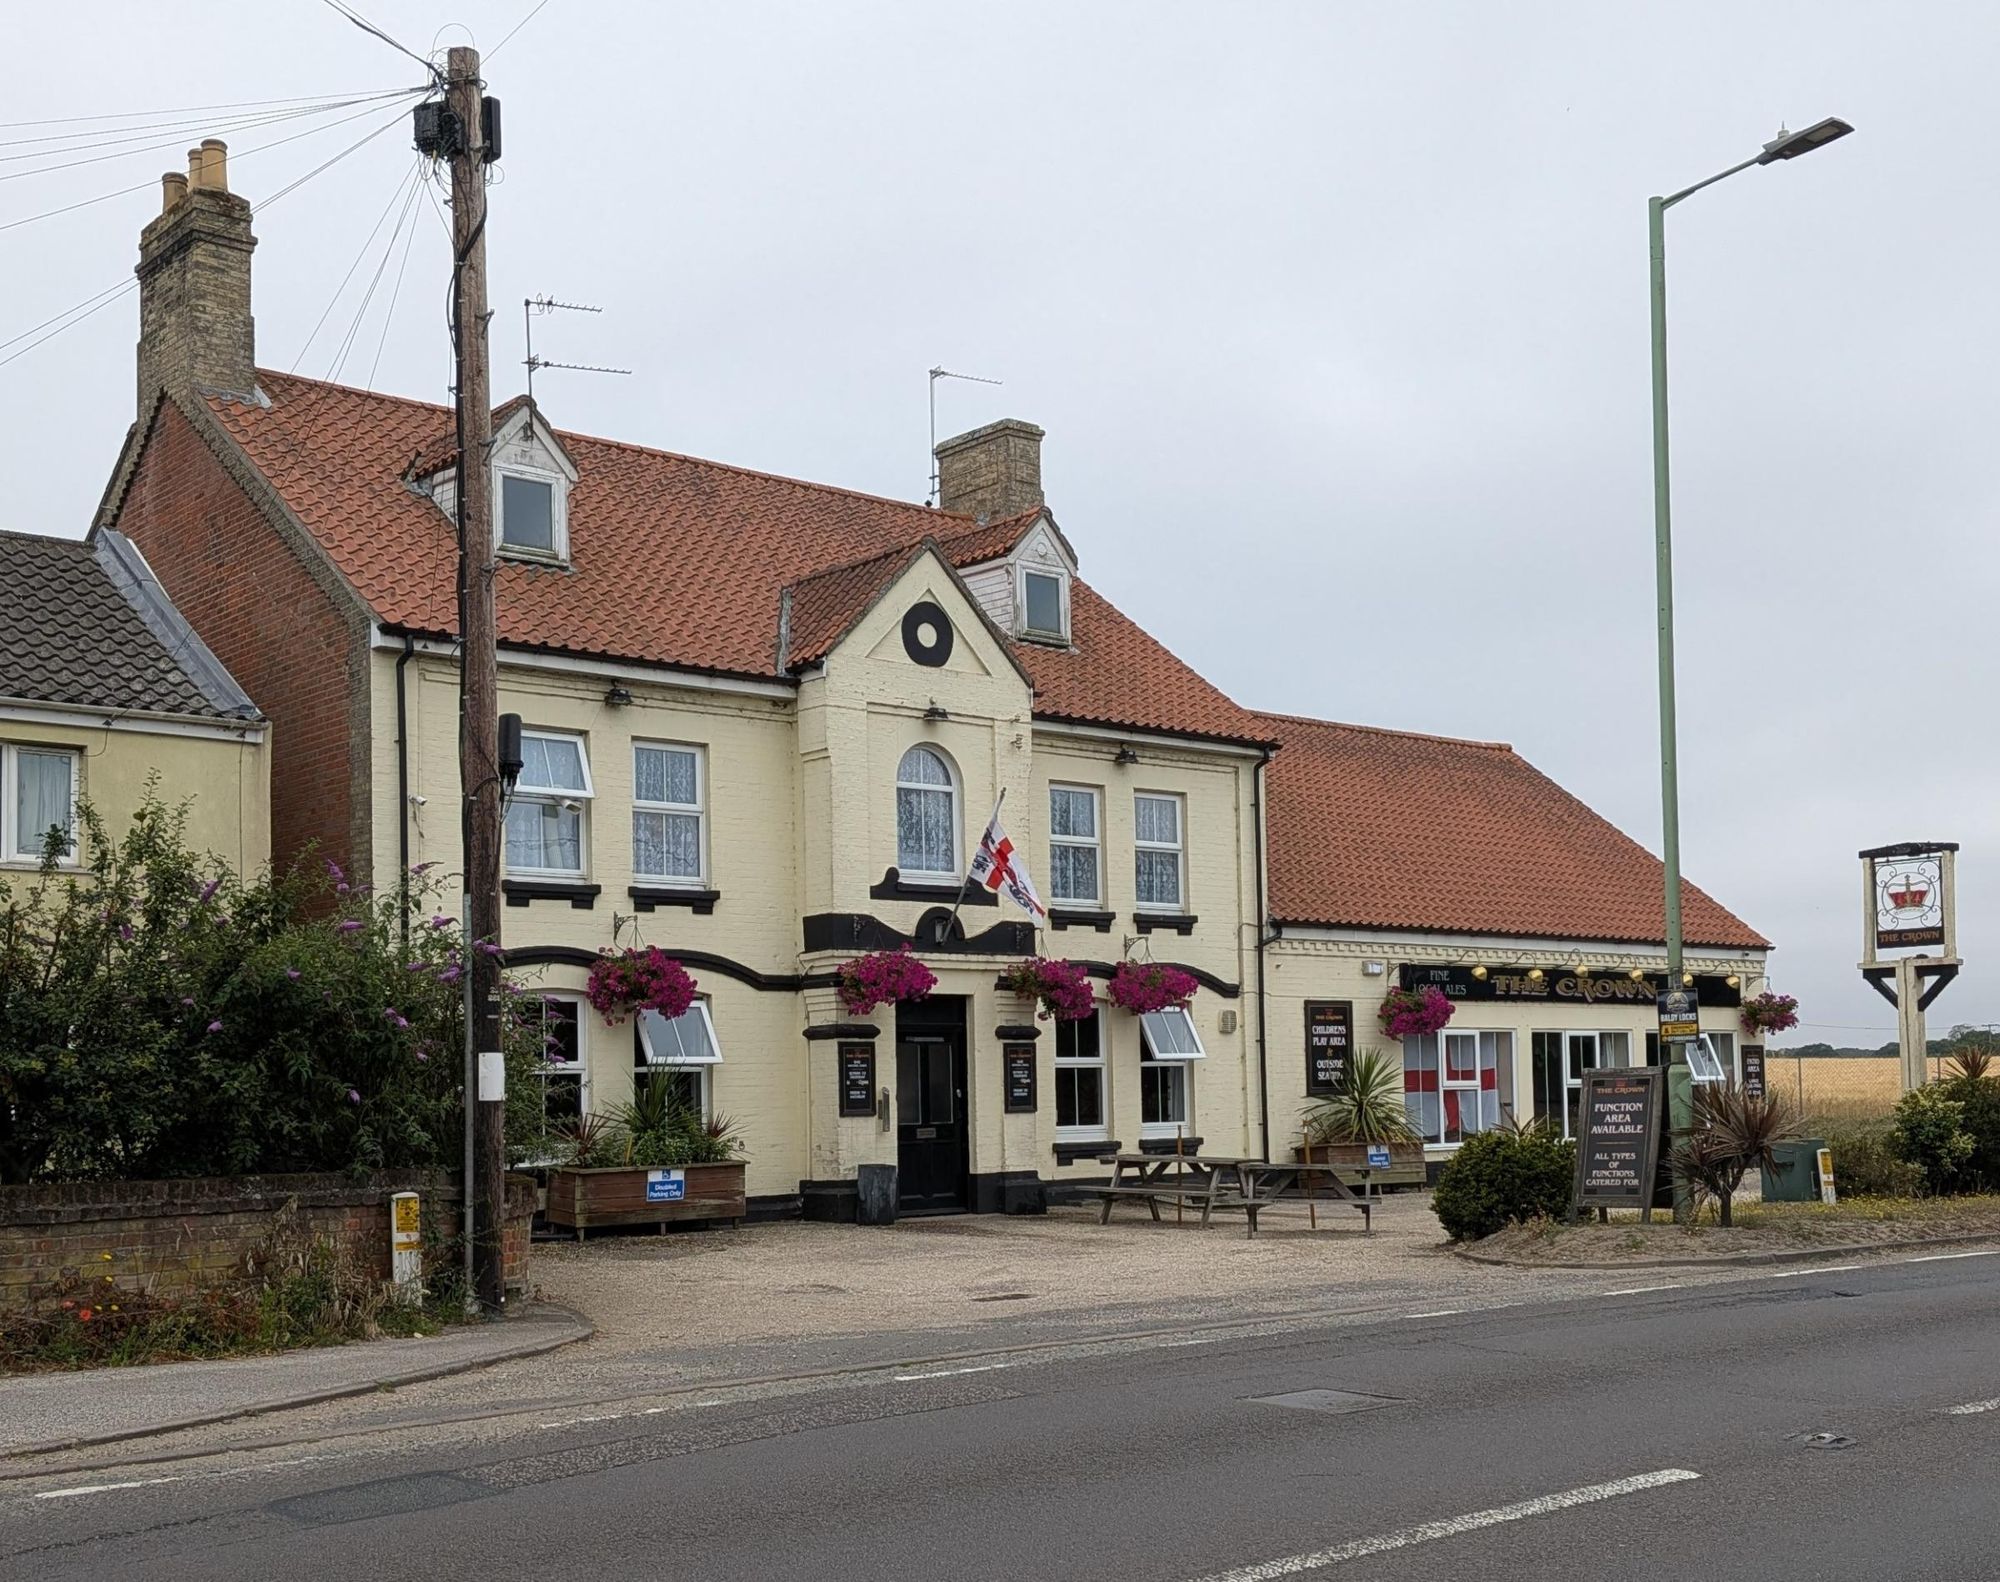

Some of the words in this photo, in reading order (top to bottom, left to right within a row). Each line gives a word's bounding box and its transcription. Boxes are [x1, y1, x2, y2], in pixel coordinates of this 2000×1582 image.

[1879, 933, 1899, 943] THE
[1901, 931, 1940, 943] CROWN
[1430, 970, 1450, 981] FINE
[1445, 984, 1467, 995] ALES
[1490, 975, 1550, 996] THE
[1556, 976, 1657, 1004] CROWN
[1312, 1025, 1346, 1035] CHILDRENS
[1312, 1036, 1328, 1046] PLAY
[1329, 1036, 1346, 1046] AREA
[1316, 1059, 1344, 1069] OUTSIDE
[1614, 1086, 1646, 1095] CROWN
[1594, 1103, 1643, 1112] FUNCTION
[1604, 1114, 1631, 1123] AREA
[1591, 1125, 1643, 1134] AVAILABLE
[1594, 1152, 1609, 1160] ALL
[1611, 1152, 1636, 1160] TYPES
[1608, 1161, 1620, 1169] OF
[1592, 1169, 1635, 1178] FUNCTIONS
[1585, 1179, 1621, 1187] CATERED
[1623, 1178, 1640, 1187] FOR
